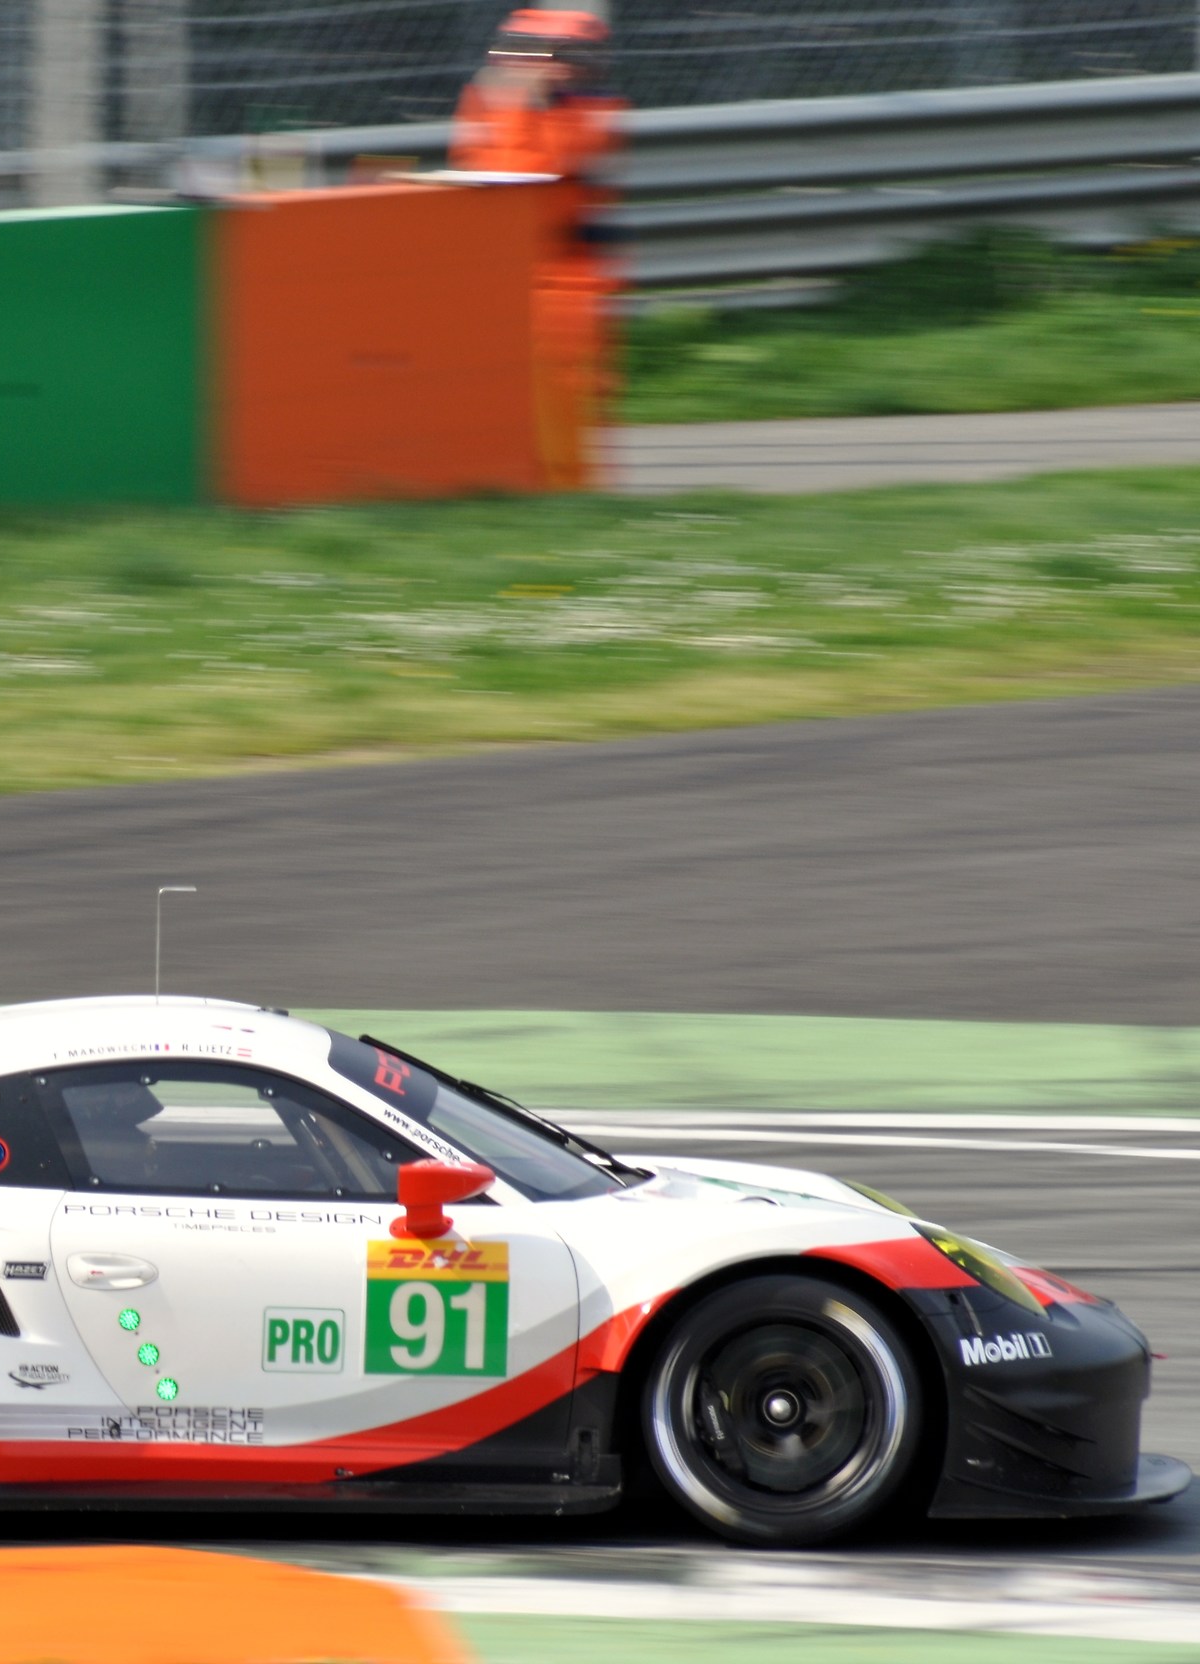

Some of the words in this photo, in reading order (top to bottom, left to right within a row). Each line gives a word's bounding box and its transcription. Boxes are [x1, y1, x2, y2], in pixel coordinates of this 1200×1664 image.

[199, 1044, 232, 1055] LIETZ
[63, 1204, 237, 1220] PORSCHE
[250, 1209, 382, 1225] DESIGN
[387, 1247, 488, 1271] DHL
[3, 1263, 46, 1277] HAZET
[388, 1280, 487, 1370] 91
[267, 1318, 341, 1365] PRO
[960, 1333, 1031, 1366] Mobil
[30, 1364, 59, 1373] ACTION
[137, 1405, 264, 1419] PORSCHE
[101, 1416, 264, 1431] INTELLIGENT
[67, 1427, 264, 1444] PERFORMANCE
